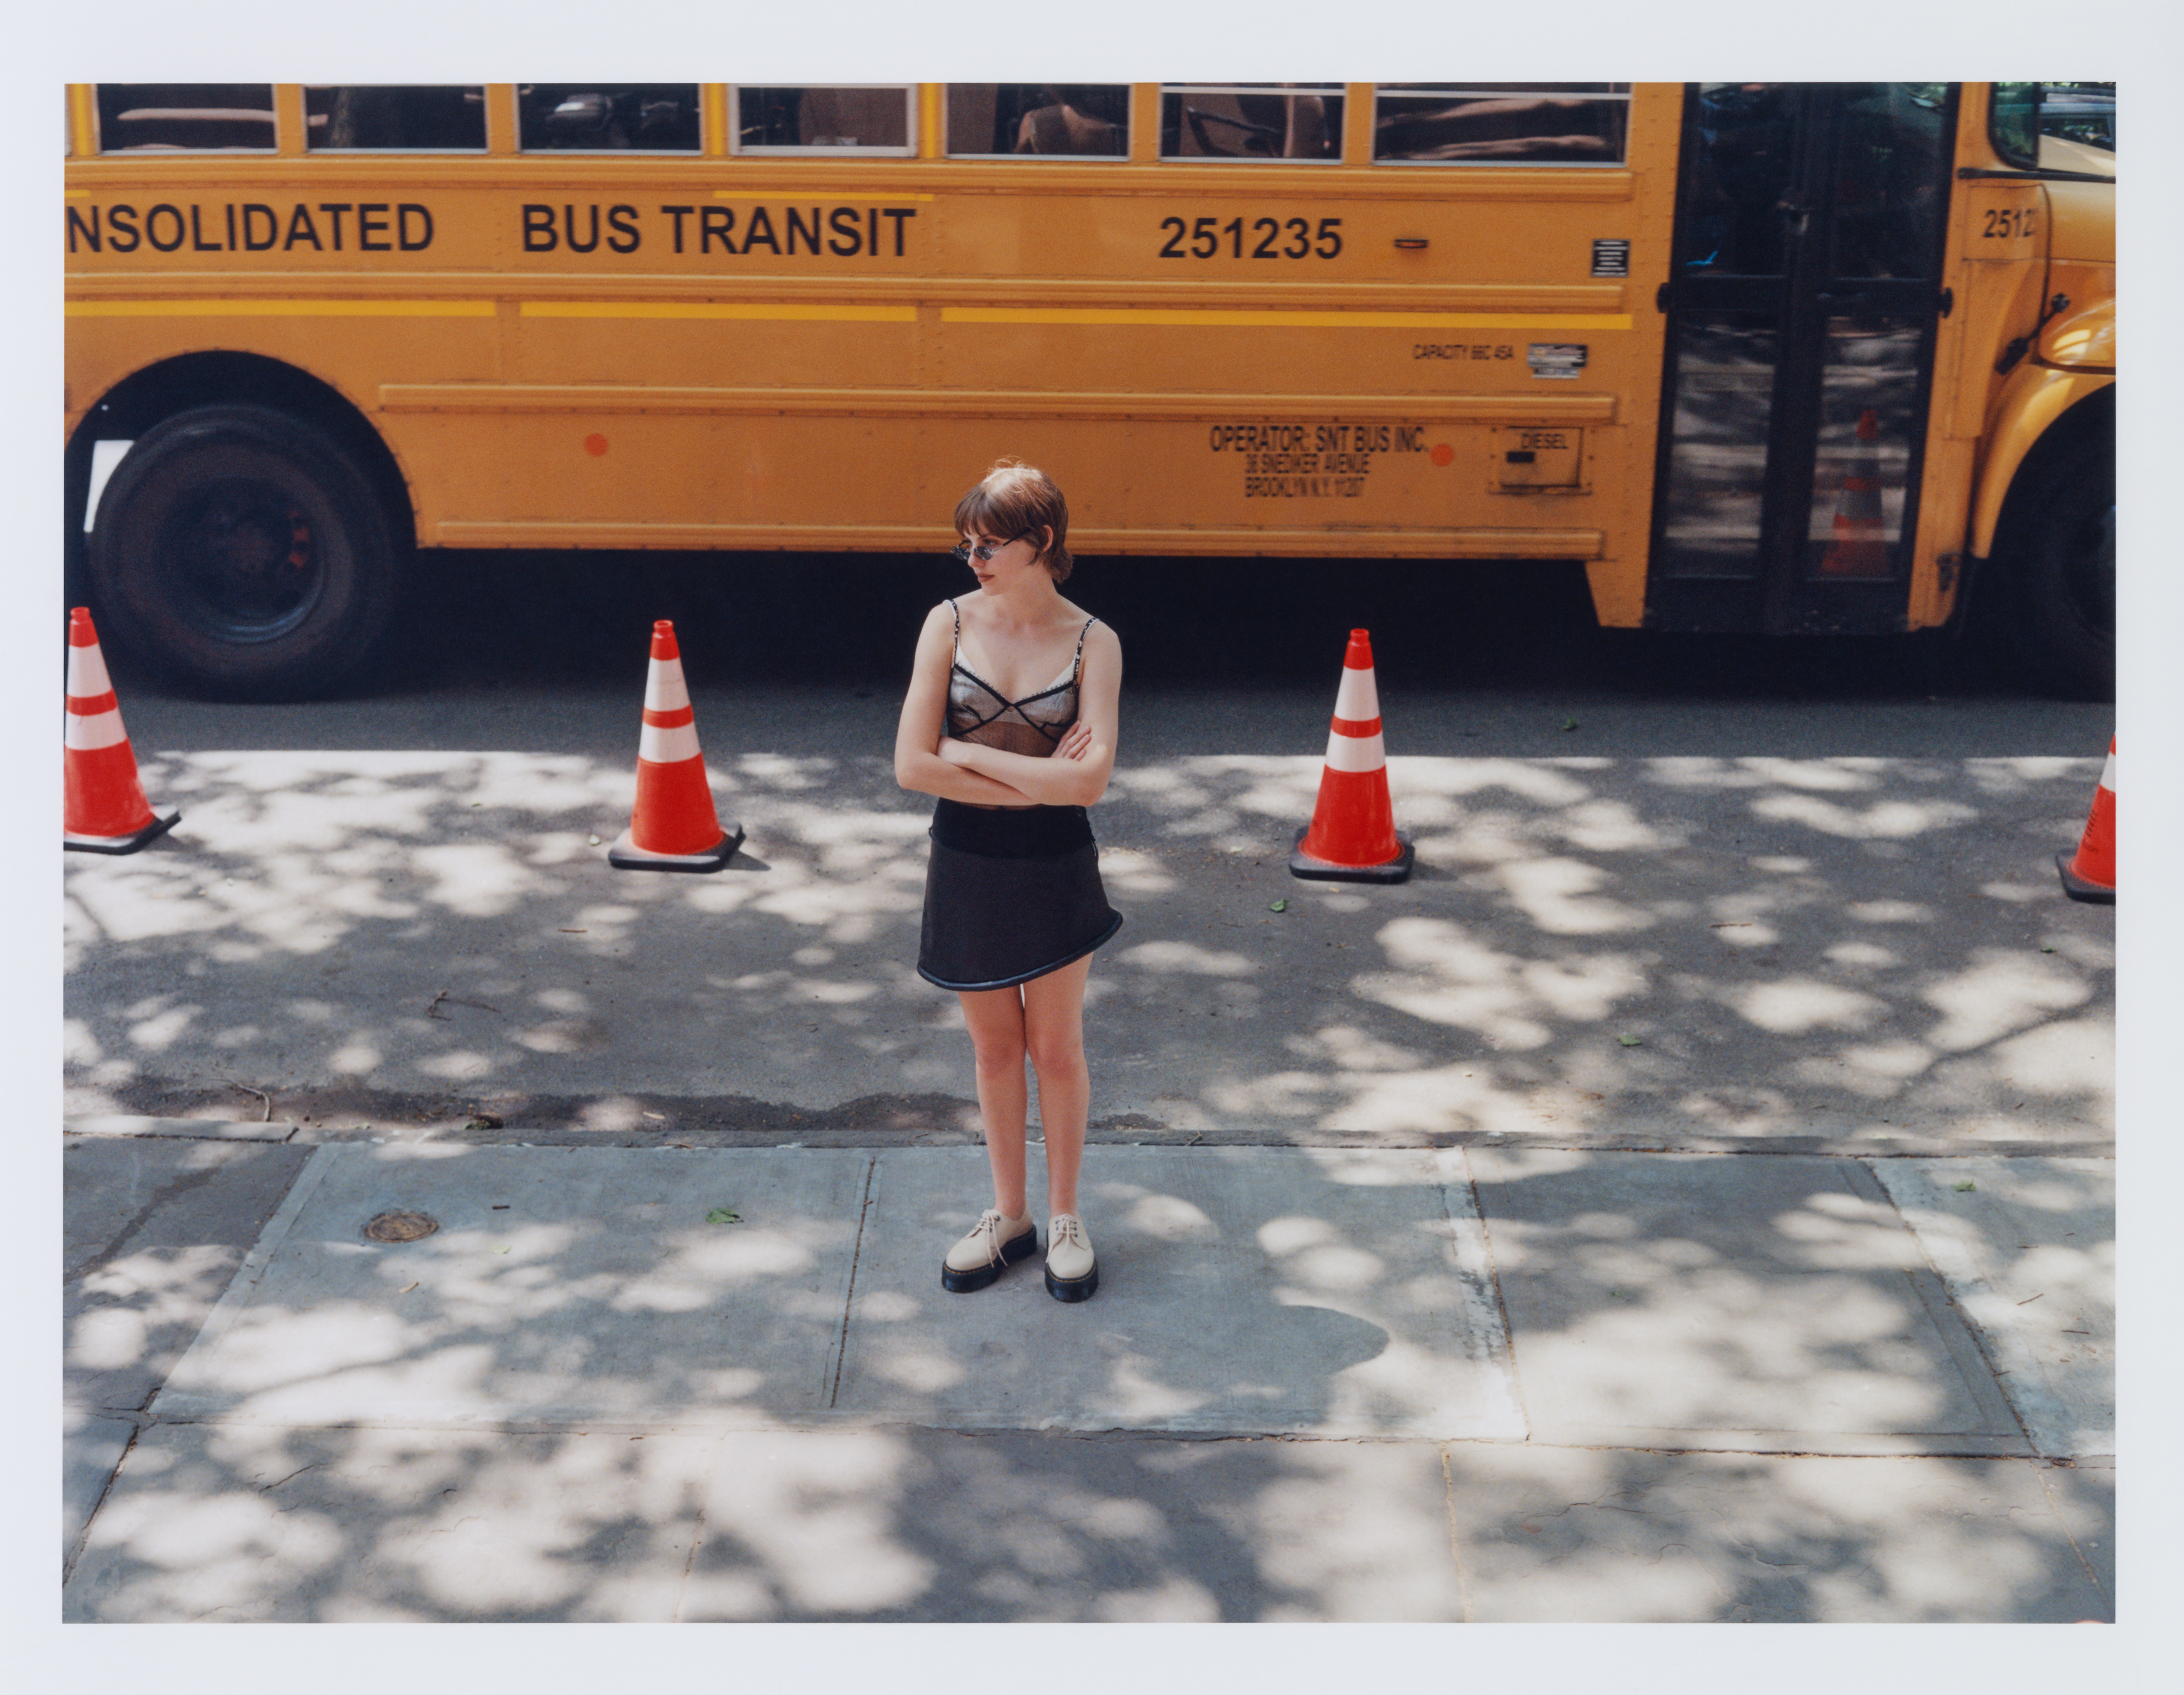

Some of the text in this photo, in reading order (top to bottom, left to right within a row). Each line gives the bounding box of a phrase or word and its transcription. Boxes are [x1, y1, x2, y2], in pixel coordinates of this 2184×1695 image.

[67, 203, 917, 257] NSOLIDATED BUS TRANSIT
[1159, 216, 1343, 260] 251235
[1413, 344, 1468, 360] CAPACITY
[1210, 426, 1429, 453] OPERATOR: SNT BUS INC.
[1521, 433, 1568, 449] DIESEL
[1325, 453, 1370, 474] AVENUE
[1245, 476, 1308, 497] BROOKLYN
